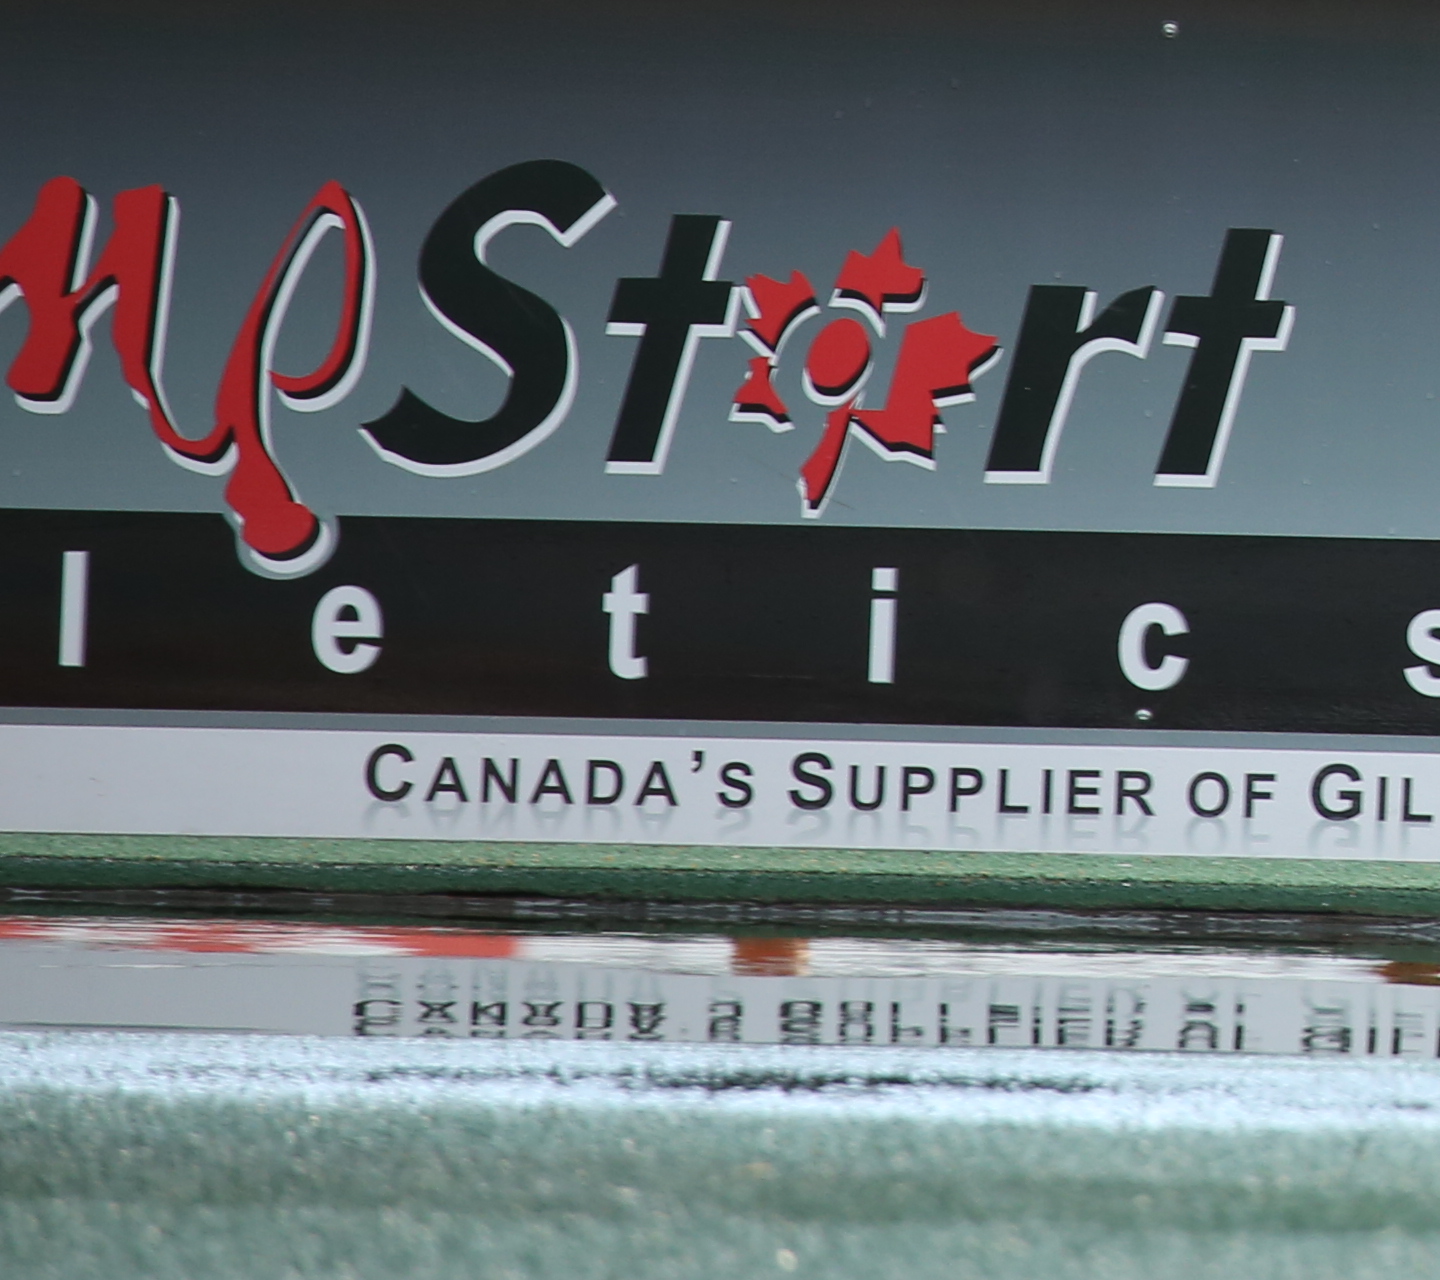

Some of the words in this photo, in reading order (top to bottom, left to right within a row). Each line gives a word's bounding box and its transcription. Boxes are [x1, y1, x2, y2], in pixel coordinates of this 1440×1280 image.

[363, 742, 757, 810] CANADA'S
[786, 751, 1155, 819] SUPPLIER
[1187, 770, 1277, 820] OF
